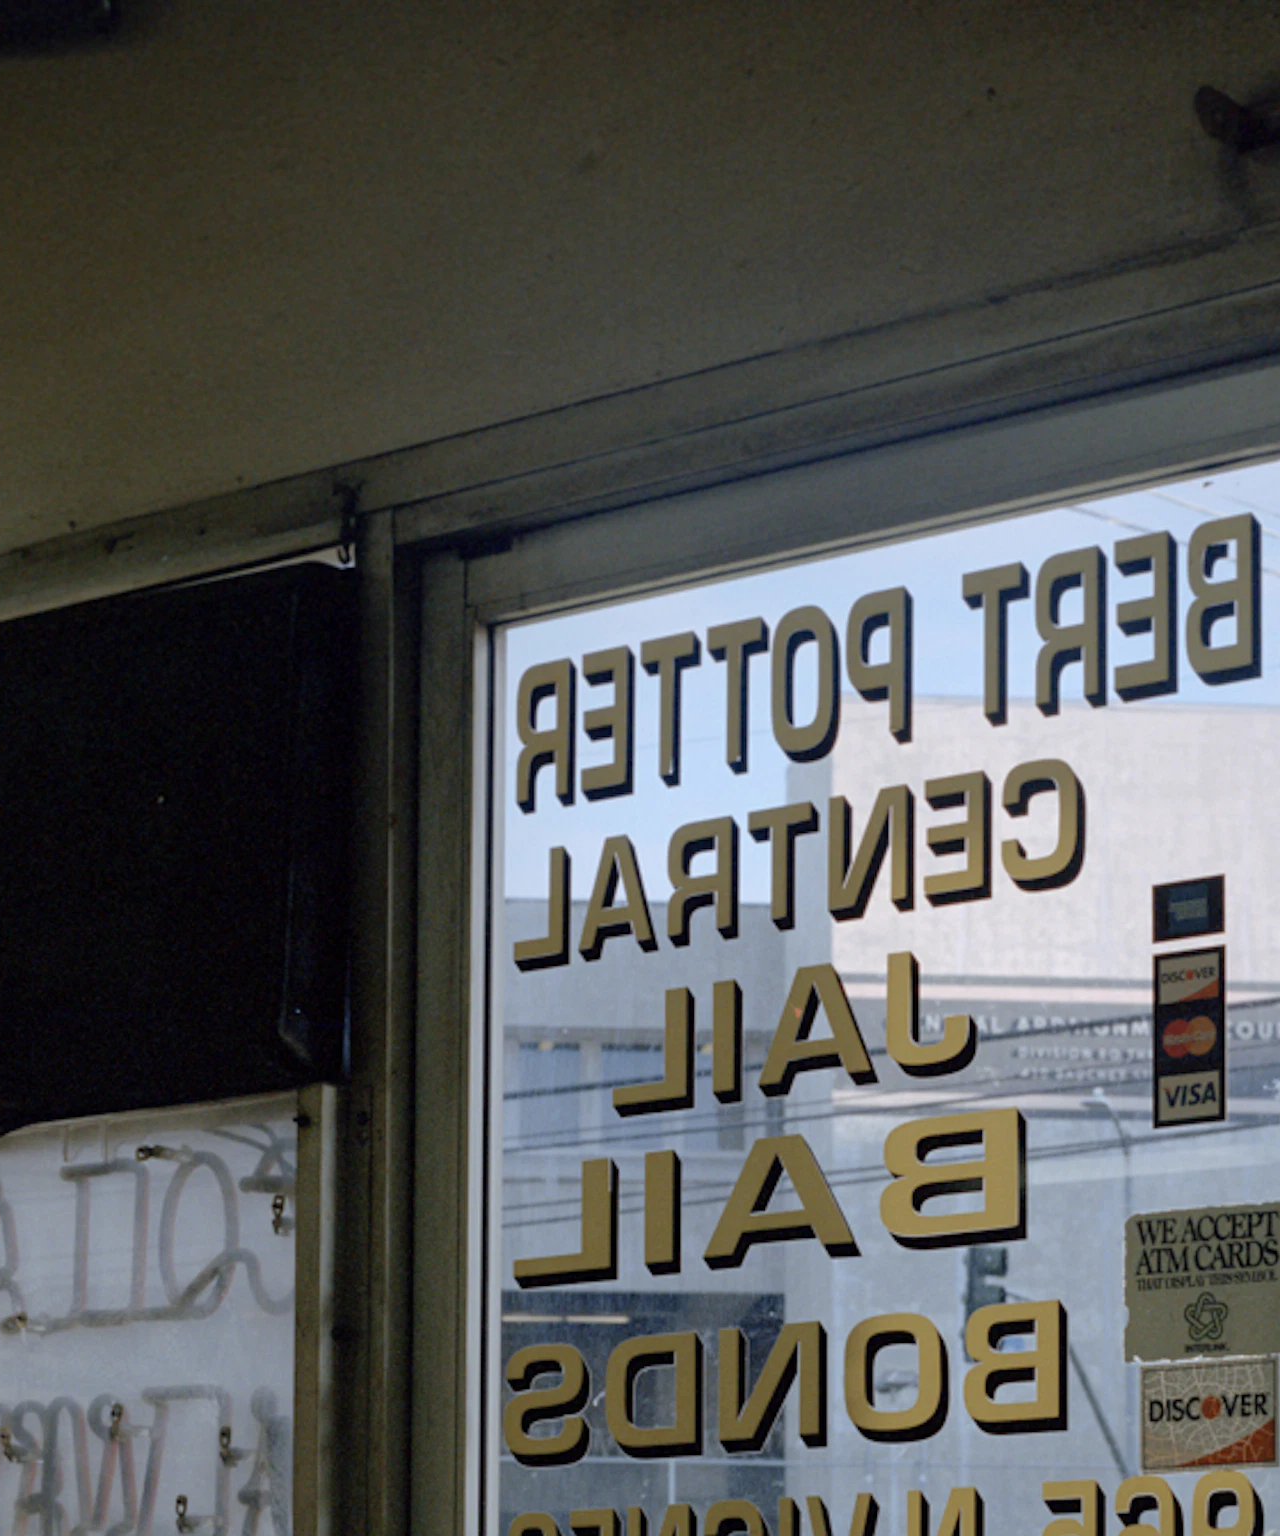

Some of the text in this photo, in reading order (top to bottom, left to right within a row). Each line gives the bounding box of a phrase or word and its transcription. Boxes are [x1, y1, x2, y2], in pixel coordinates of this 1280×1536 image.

[1161, 966, 1215, 984] DISCOVER
[1164, 1081, 1217, 1107] VISA
[1136, 1211, 1280, 1246] WE ACCEPT
[1136, 1239, 1280, 1276] ATM CARDS
[1149, 1393, 1267, 1422] DISCOVER
